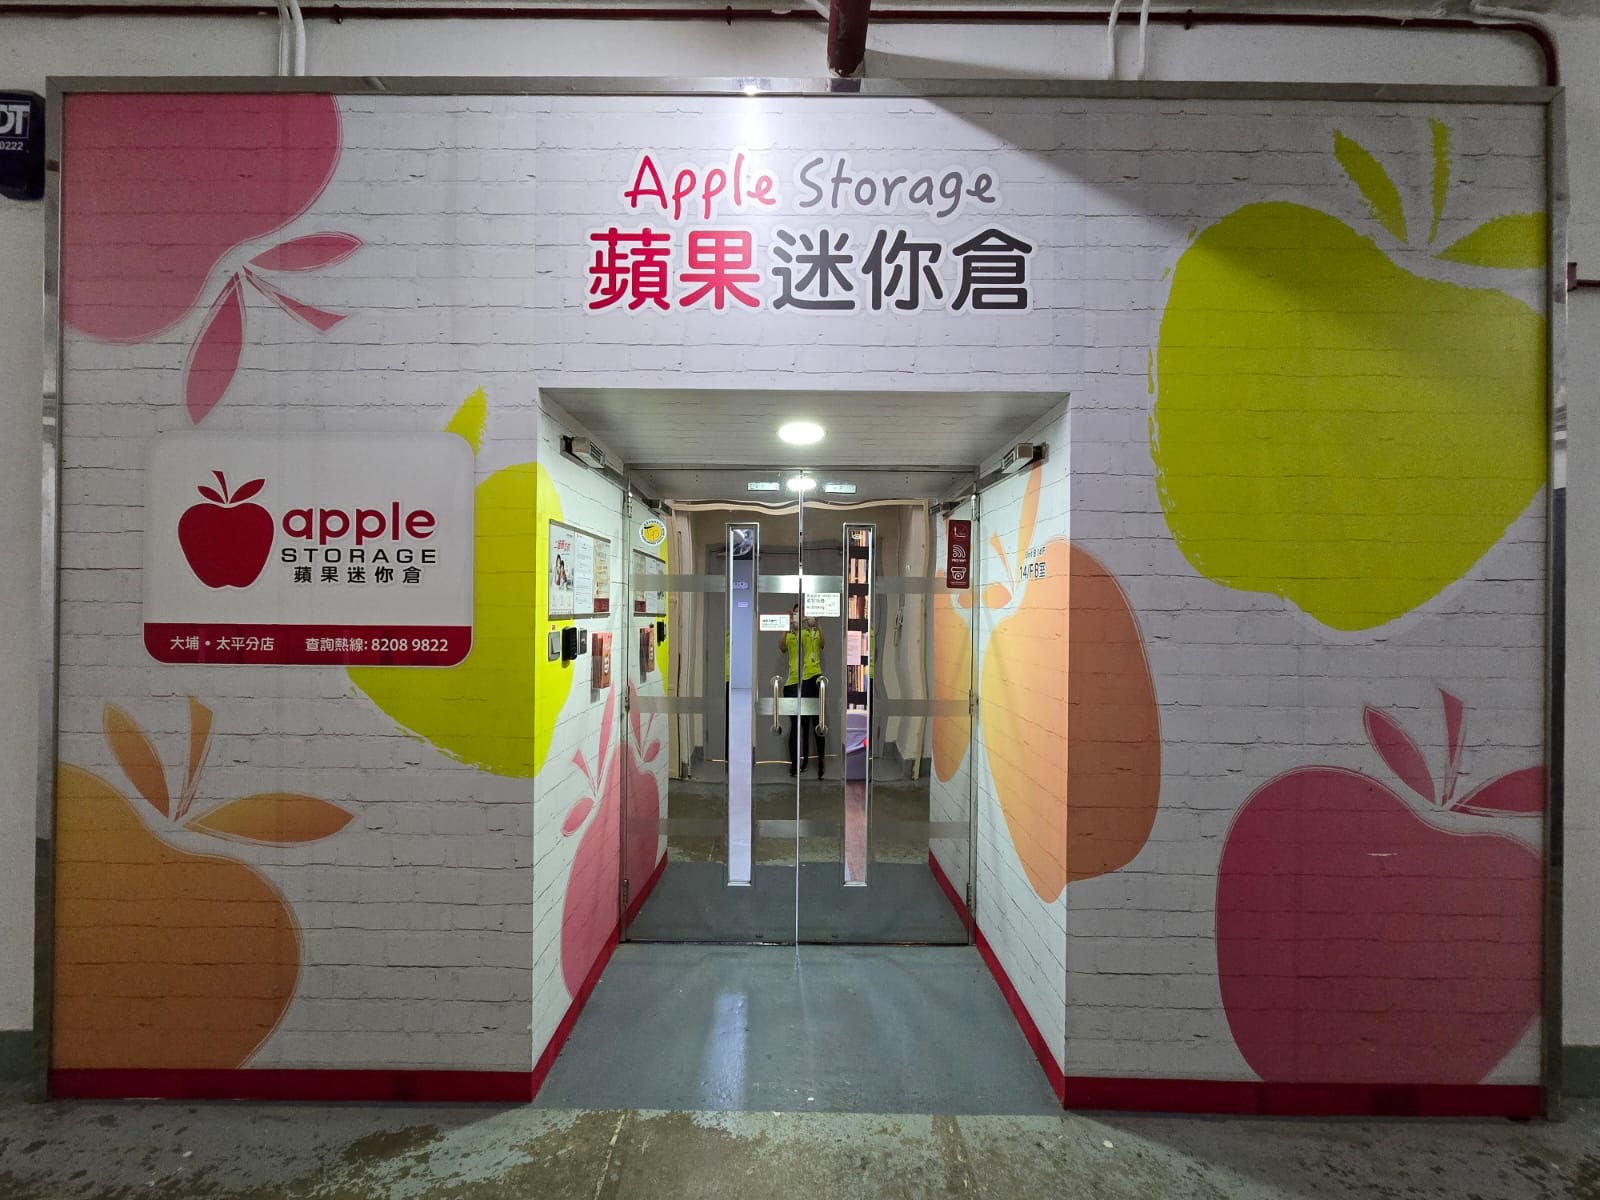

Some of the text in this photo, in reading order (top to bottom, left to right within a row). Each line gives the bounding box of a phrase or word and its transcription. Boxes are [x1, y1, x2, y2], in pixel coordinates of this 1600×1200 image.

[624, 152, 996, 220] Apple Storage
[588, 226, 1034, 311] 蘋果迷你倉
[281, 501, 436, 546] apple
[280, 547, 437, 564] STORAGE
[293, 565, 423, 584] 蘋果迷你倉
[170, 635, 200, 651] 大埔
[216, 636, 275, 651] 太平分店
[371, 638, 408, 652] 8208
[412, 639, 449, 652] 9822
